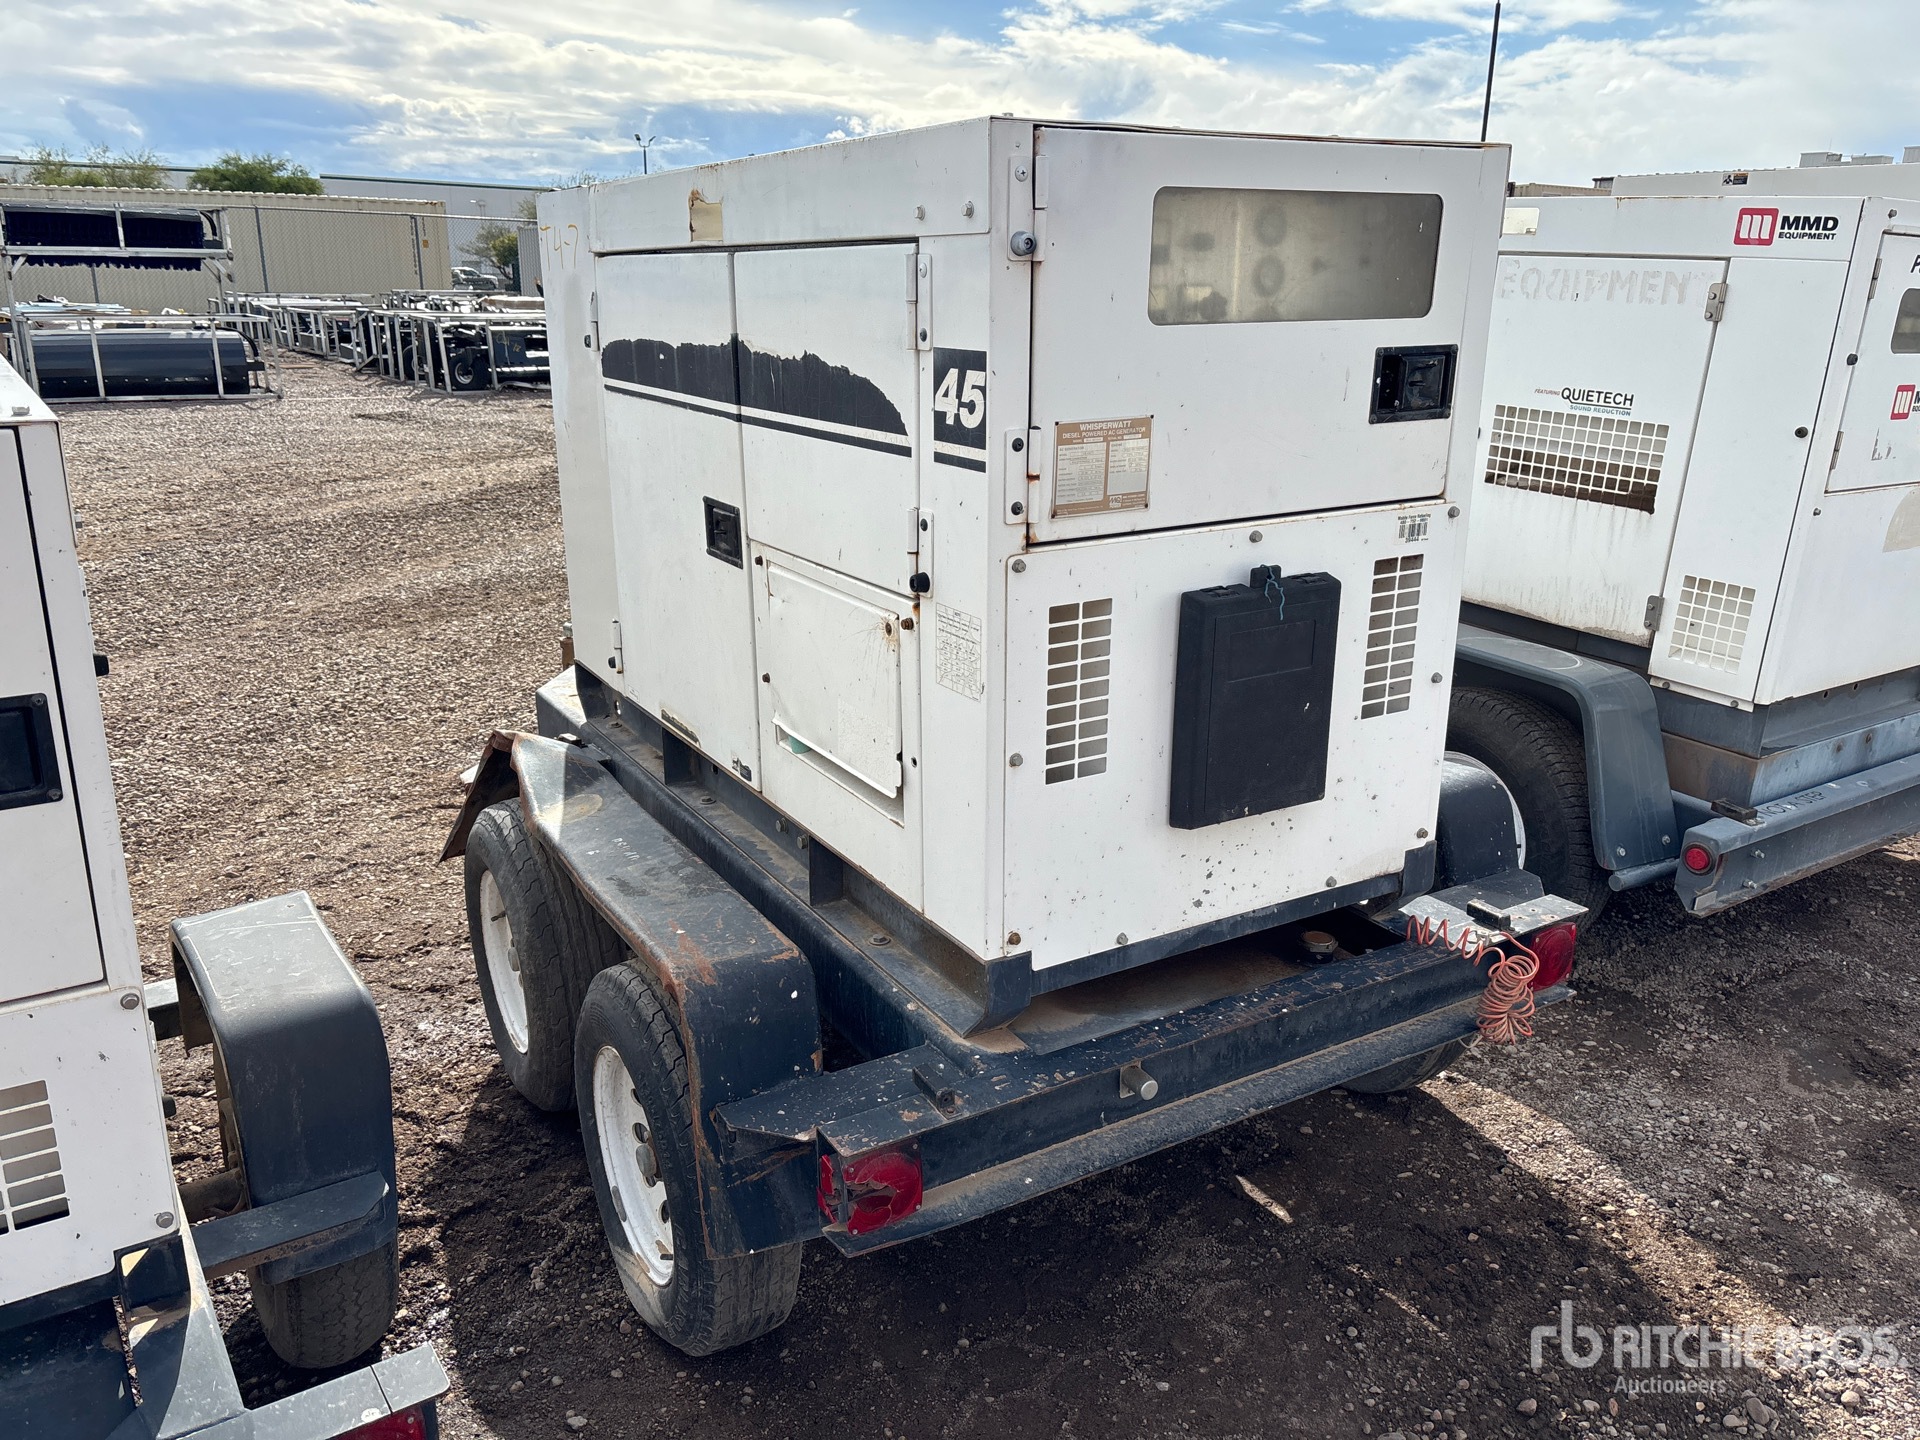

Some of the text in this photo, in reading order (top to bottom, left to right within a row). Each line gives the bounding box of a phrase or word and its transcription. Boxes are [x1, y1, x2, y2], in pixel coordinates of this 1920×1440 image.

[1780, 215, 1839, 232] MMD
[1778, 231, 1837, 241] EQUIPMENT
[934, 368, 986, 429] 45
[1534, 387, 1634, 408] FEATURING QUIETECH
[1593, 407, 1631, 416] REDUCTION
[1080, 420, 1132, 431] WHISPERWATT
[1081, 430, 1107, 438] POWERED
[1116, 427, 1146, 435] GENERATOR
